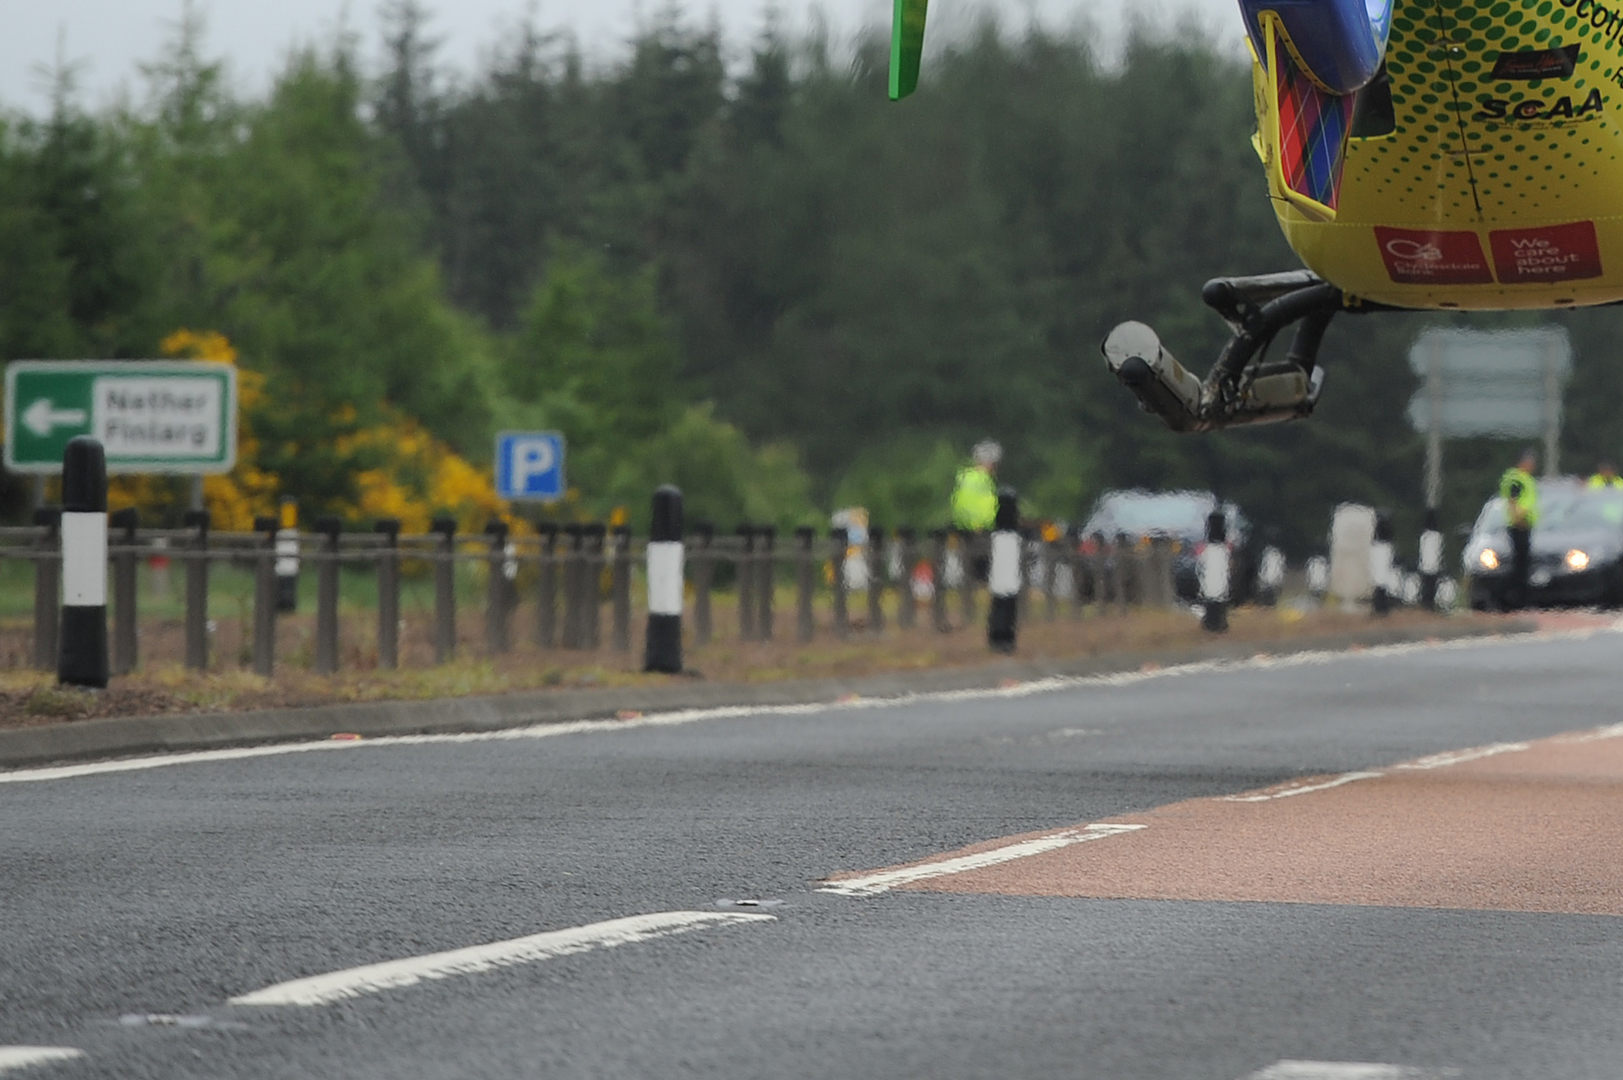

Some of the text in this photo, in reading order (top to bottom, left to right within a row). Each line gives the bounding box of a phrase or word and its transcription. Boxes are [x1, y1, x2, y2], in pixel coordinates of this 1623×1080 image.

[1476, 87, 1603, 120] SCAA
[1510, 237, 1550, 249] We
[1515, 246, 1560, 257] care
[1516, 252, 1581, 265] about
[1518, 264, 1566, 274] here
[106, 388, 206, 411] Nether
[512, 440, 554, 496] P
